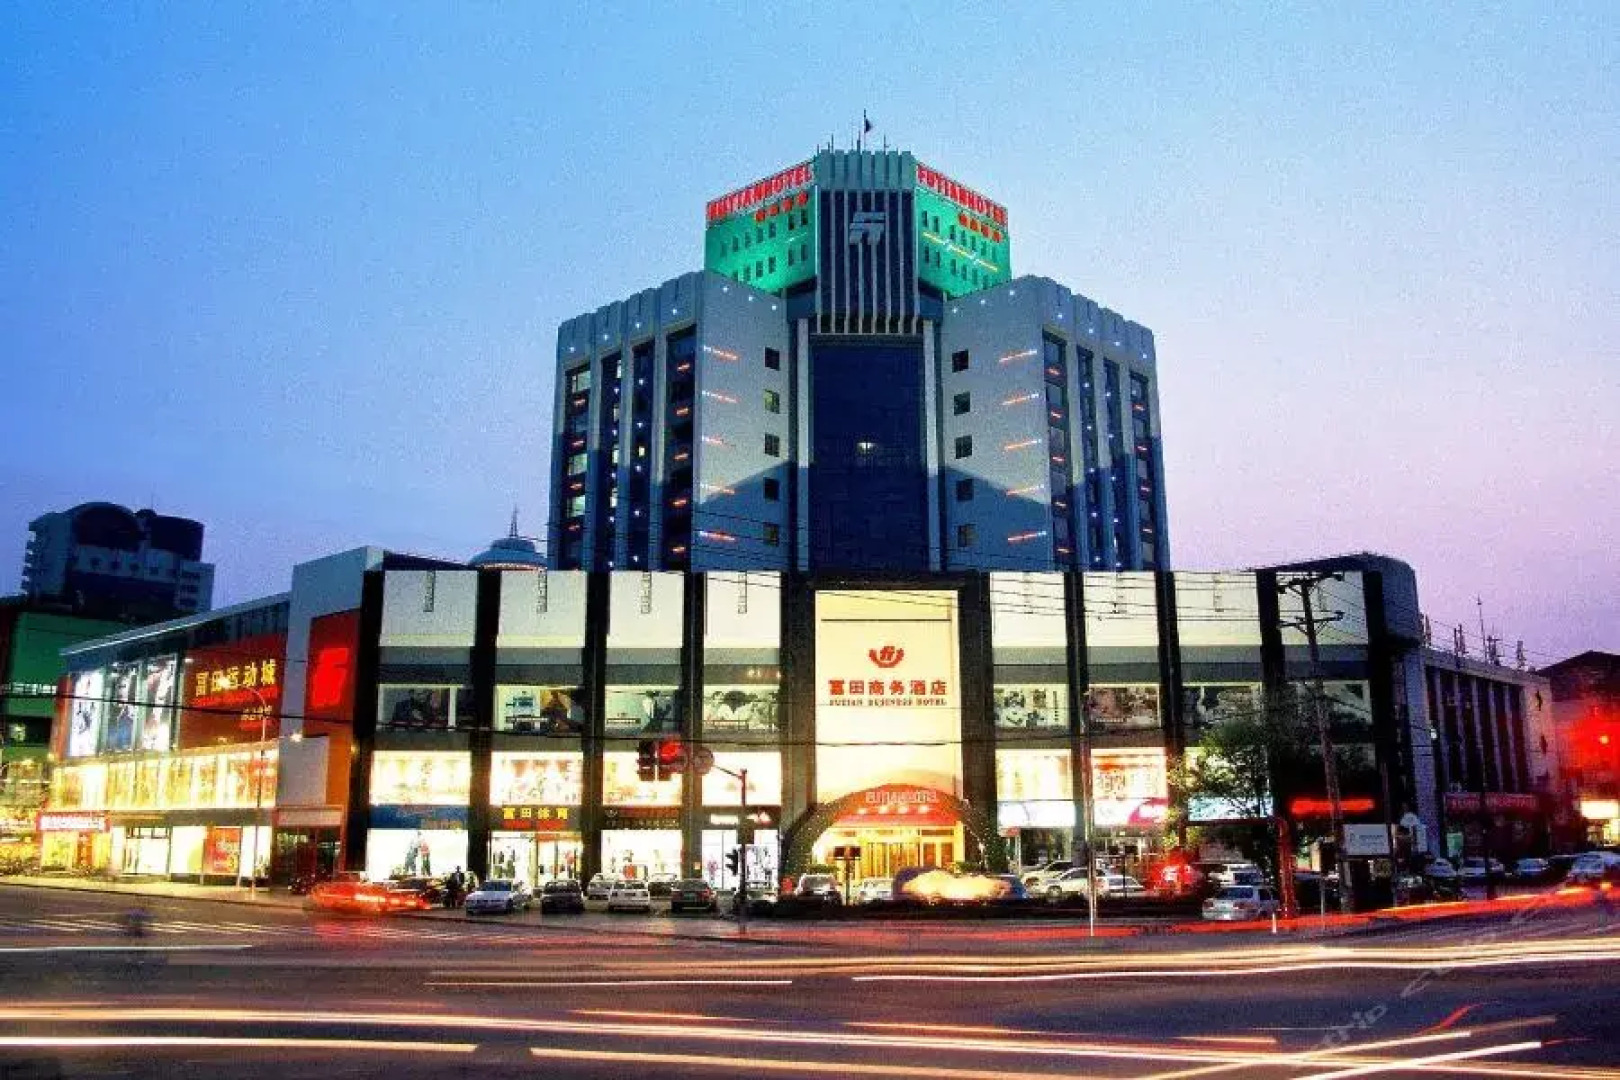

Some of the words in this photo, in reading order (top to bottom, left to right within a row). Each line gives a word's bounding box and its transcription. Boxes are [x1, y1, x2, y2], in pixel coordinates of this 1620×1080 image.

[828, 679, 947, 695] 富田商务酒店
